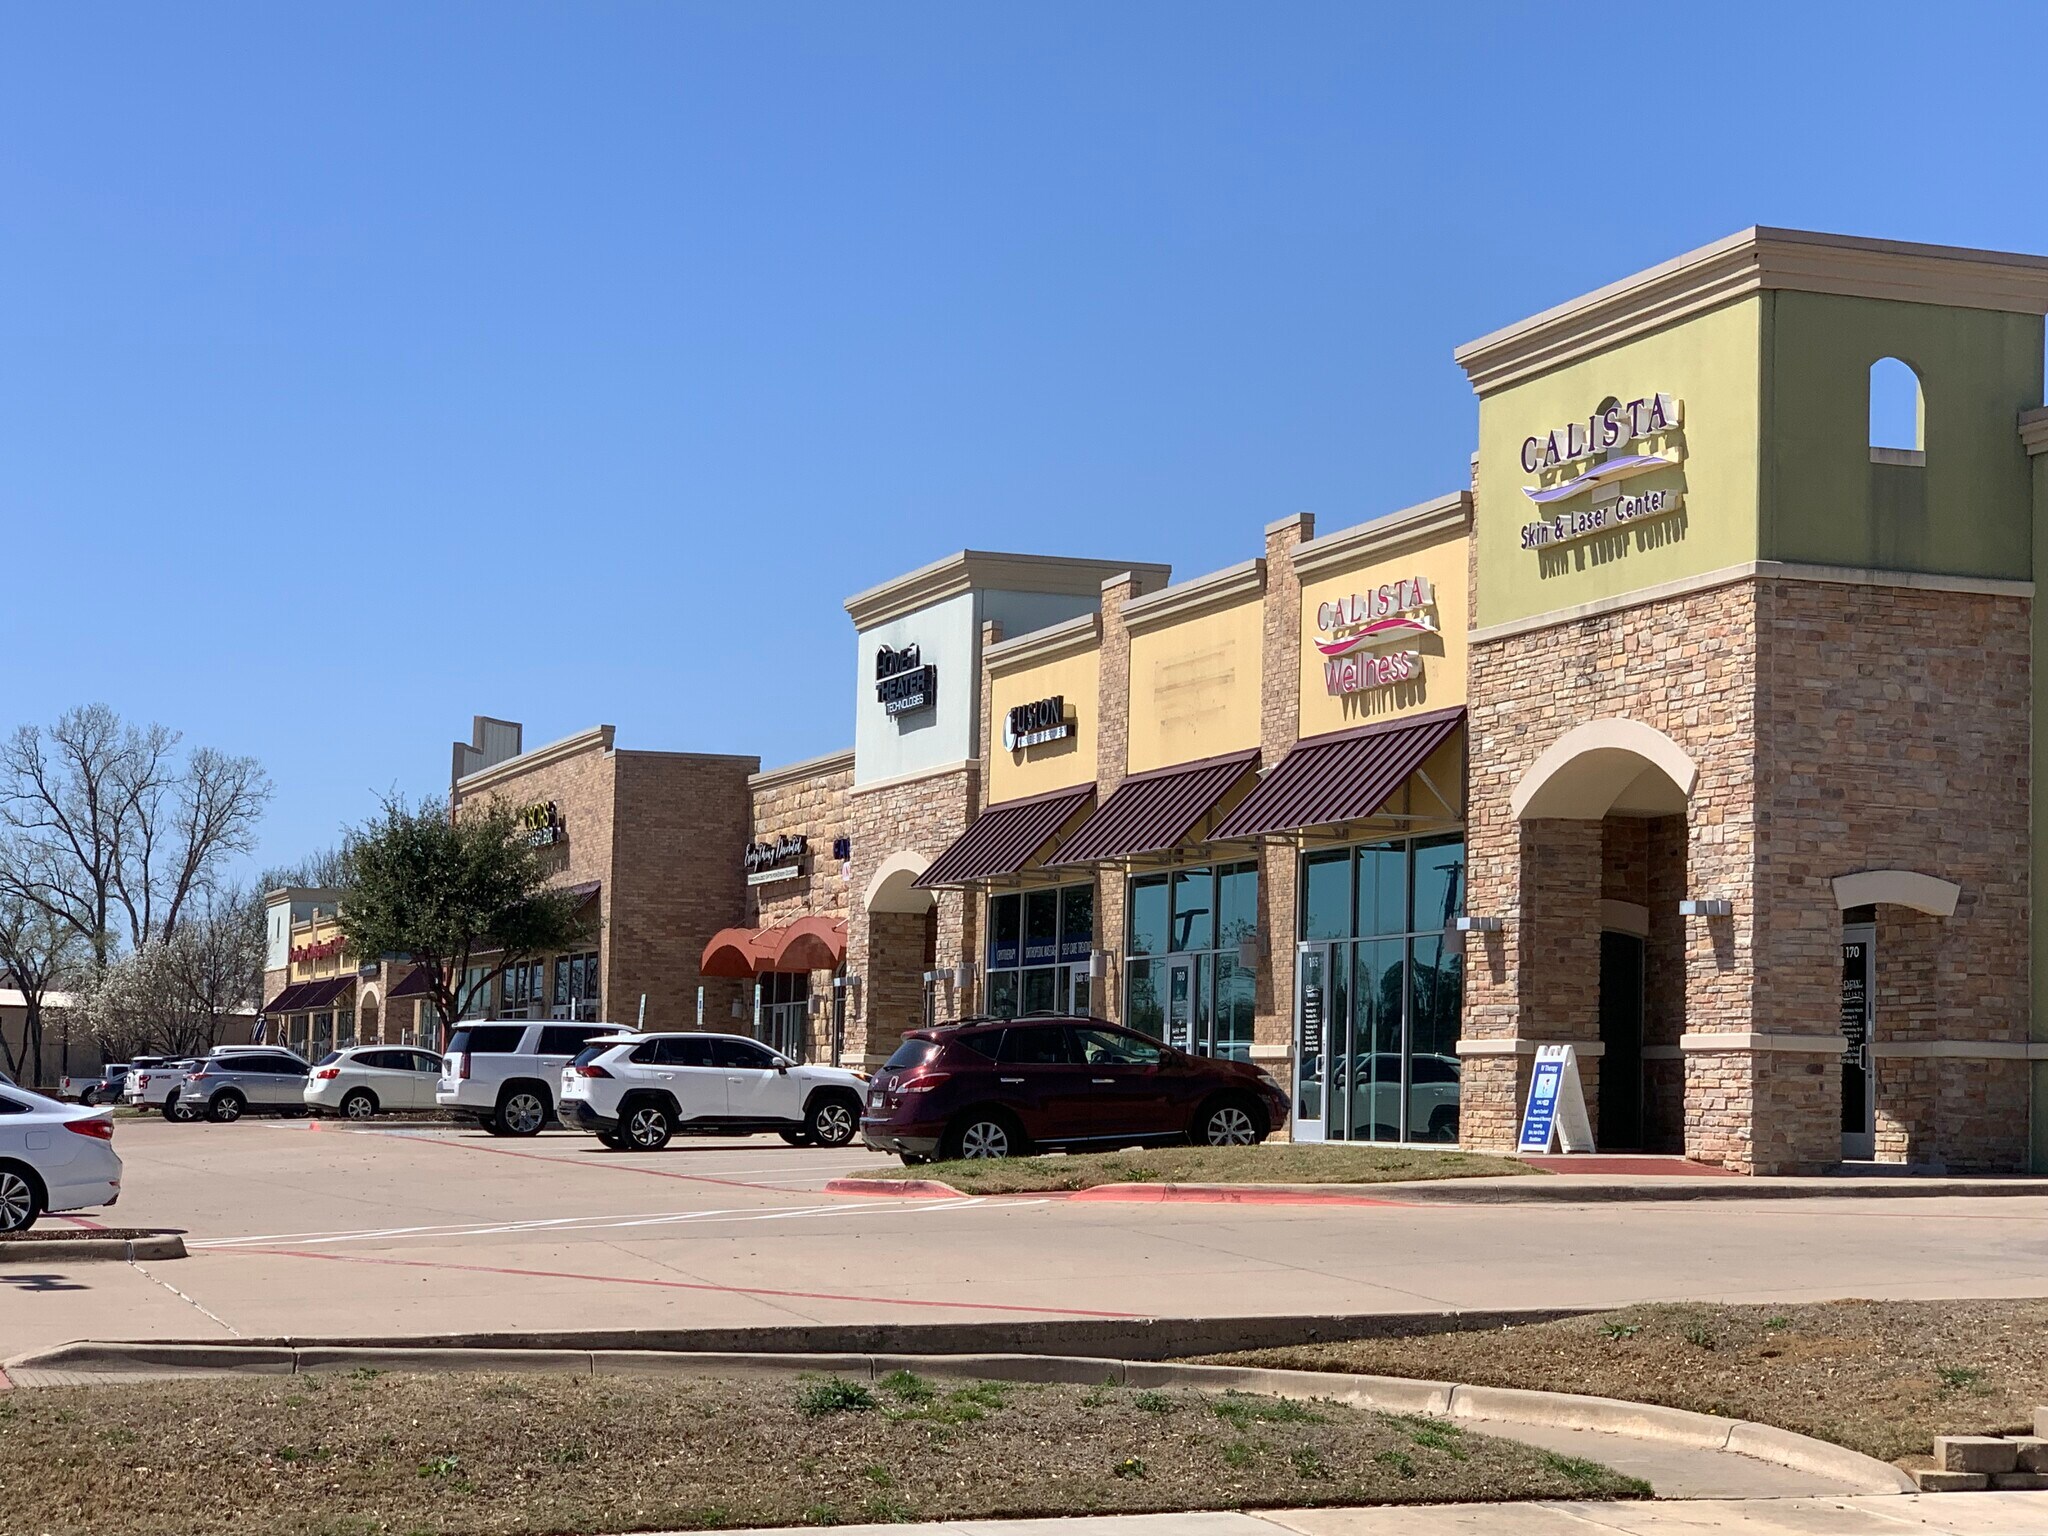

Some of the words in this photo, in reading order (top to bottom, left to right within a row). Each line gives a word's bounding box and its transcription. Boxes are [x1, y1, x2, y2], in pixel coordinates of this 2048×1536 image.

[1520, 392, 1669, 474] CALISTA
[1520, 523, 1548, 550] Skin
[1554, 515, 1564, 539] &
[1571, 506, 1608, 535] Laser
[1615, 490, 1667, 521] Center
[1317, 576, 1424, 631] CALISTA
[875, 670, 925, 703] THEATER
[1323, 651, 1410, 695] Wellness
[1010, 697, 1061, 735] FUSION
[1846, 946, 1860, 959] 170
